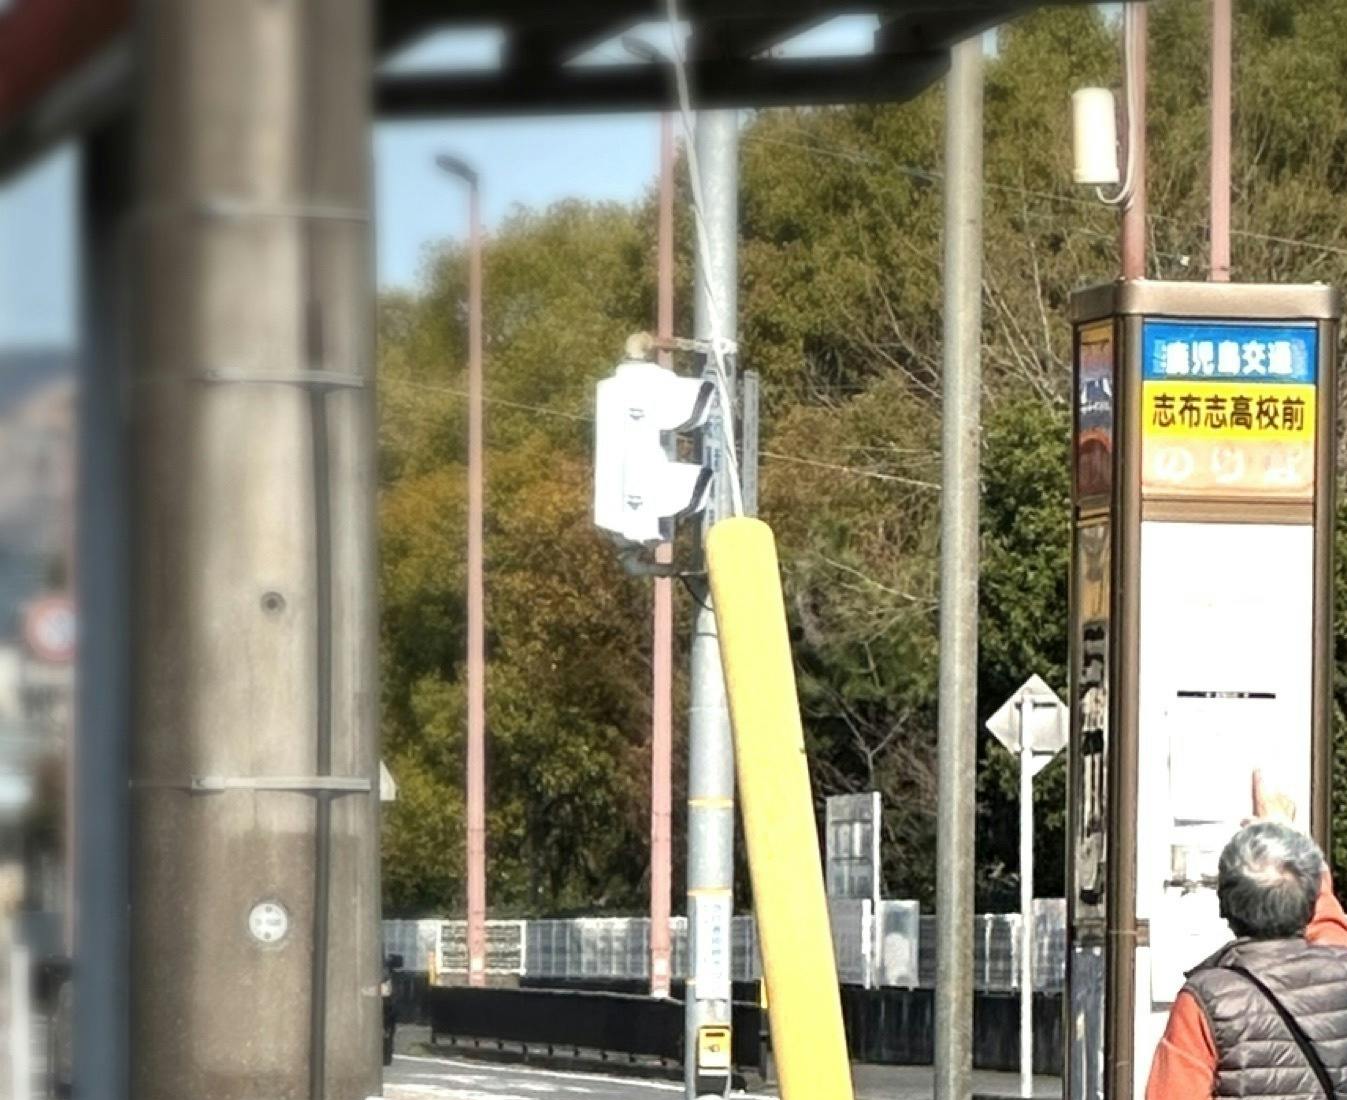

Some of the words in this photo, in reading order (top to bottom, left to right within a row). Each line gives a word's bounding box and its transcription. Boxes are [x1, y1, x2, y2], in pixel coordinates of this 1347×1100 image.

[1152, 393, 1306, 431] 志布志高校前
